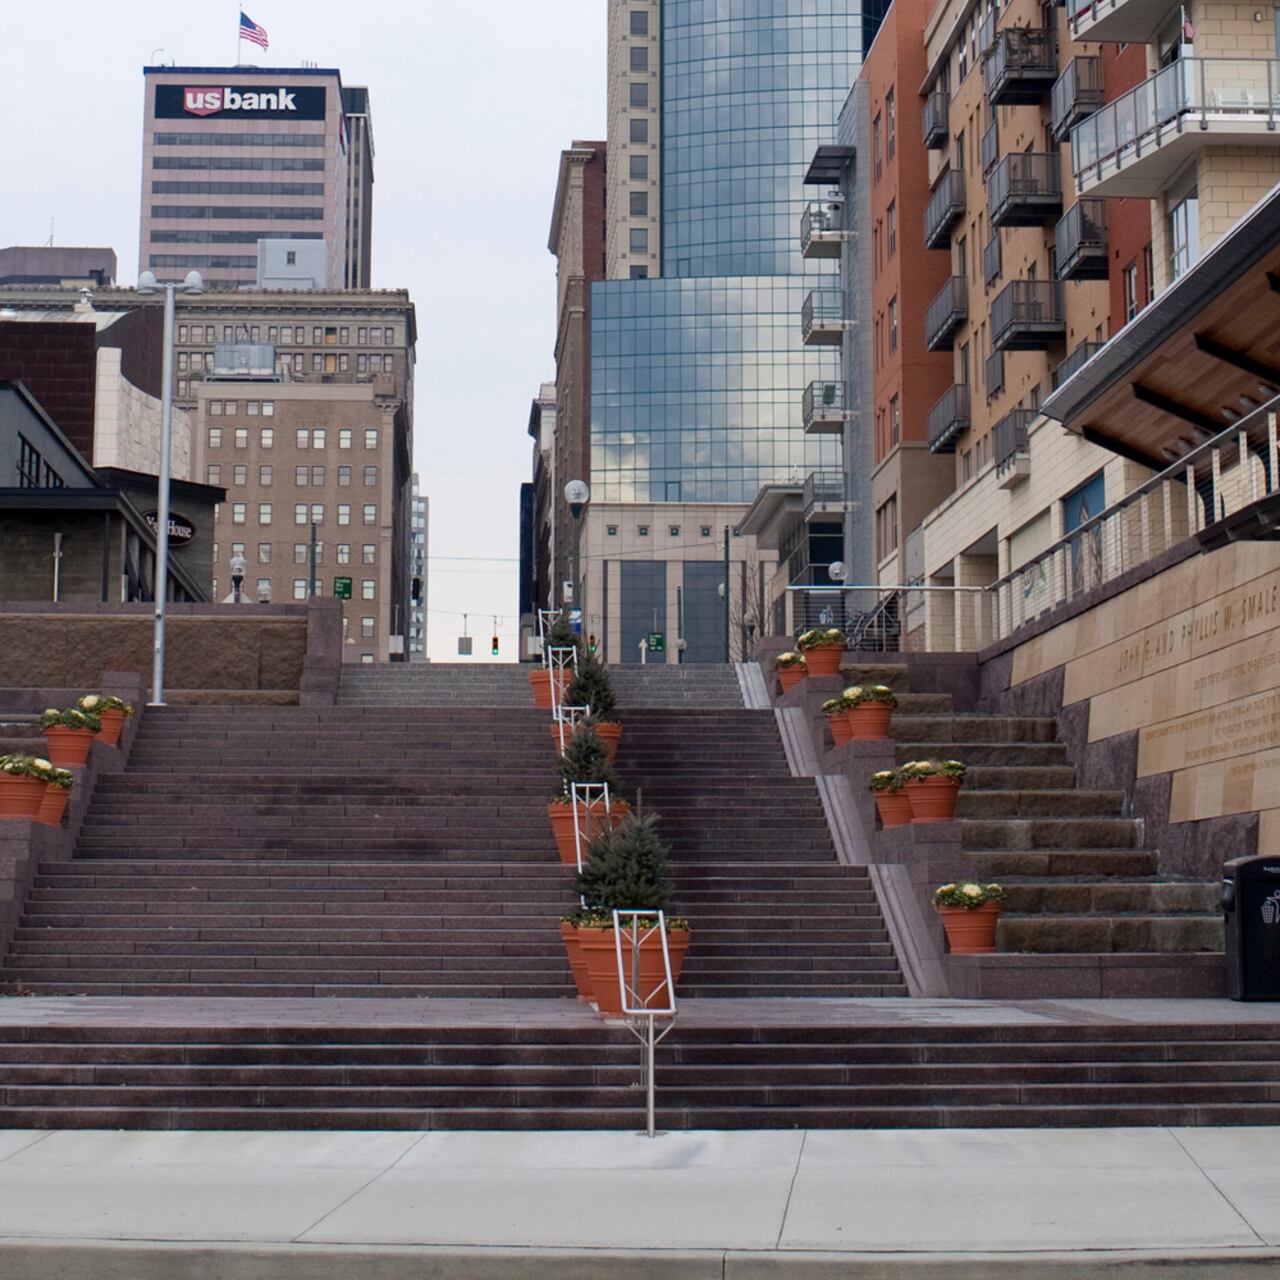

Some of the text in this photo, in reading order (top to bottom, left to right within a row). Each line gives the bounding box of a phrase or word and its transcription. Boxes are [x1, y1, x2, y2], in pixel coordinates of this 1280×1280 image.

[167, 520, 192, 538] House
[1182, 612, 1218, 644] PHYLLIS
[1241, 586, 1277, 624] SMALE
